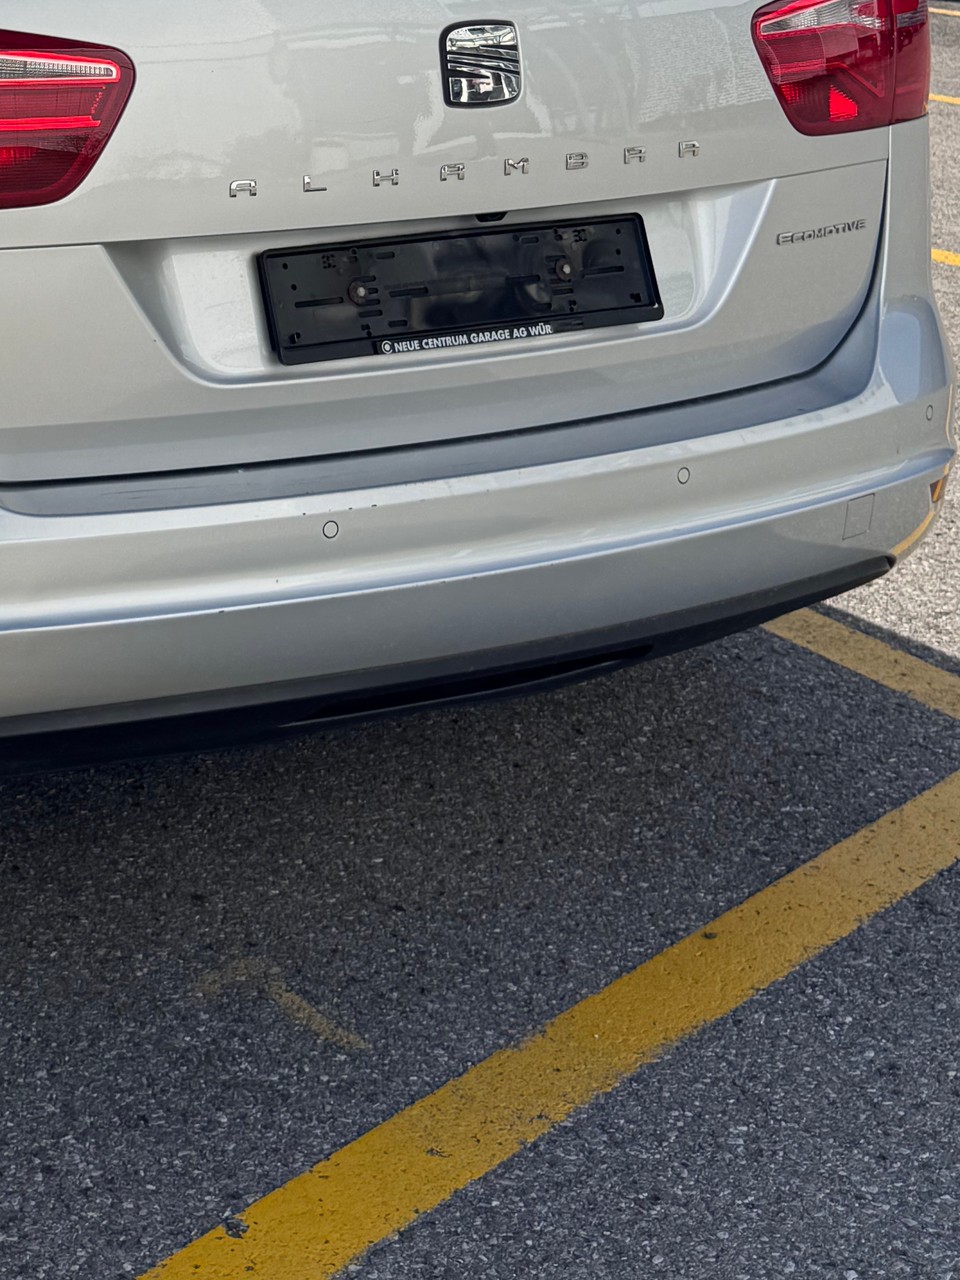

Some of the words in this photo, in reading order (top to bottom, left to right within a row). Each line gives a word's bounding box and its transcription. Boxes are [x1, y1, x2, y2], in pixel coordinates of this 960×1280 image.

[229, 140, 701, 198] ALHAMBRA
[394, 339, 421, 353] NEUE
[422, 333, 469, 350] CENTRUM
[470, 328, 511, 344] GARAGE
[512, 326, 528, 339] AG
